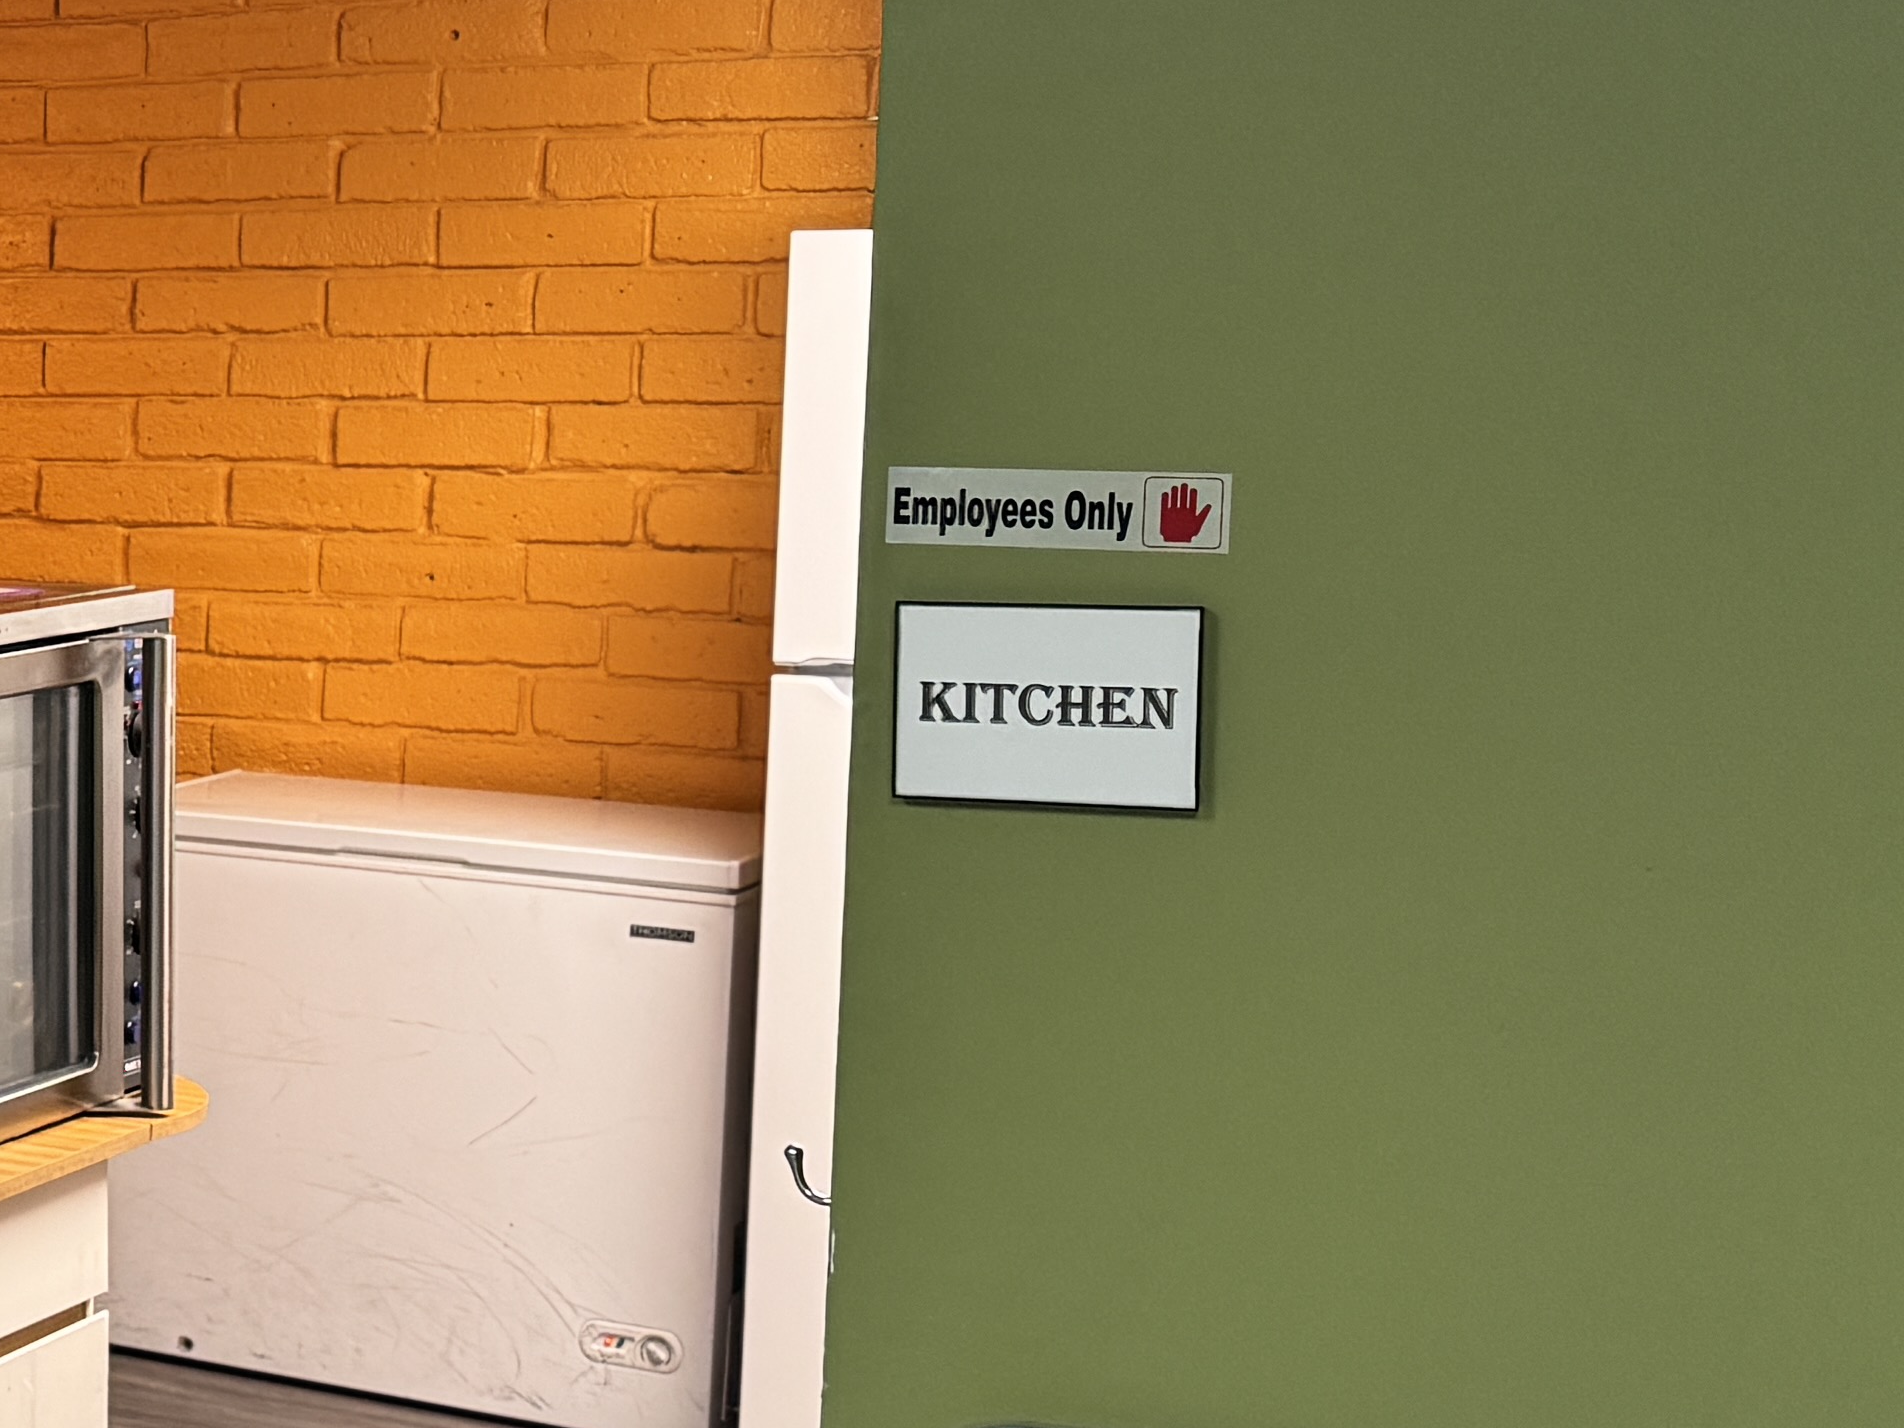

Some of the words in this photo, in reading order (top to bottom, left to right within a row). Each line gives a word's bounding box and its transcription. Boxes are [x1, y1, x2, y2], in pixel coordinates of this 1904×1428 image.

[893, 487, 1054, 537] Employees
[1065, 490, 1133, 541] Only
[919, 681, 1178, 729] KITCHEN
[633, 925, 694, 940] THOMSON
